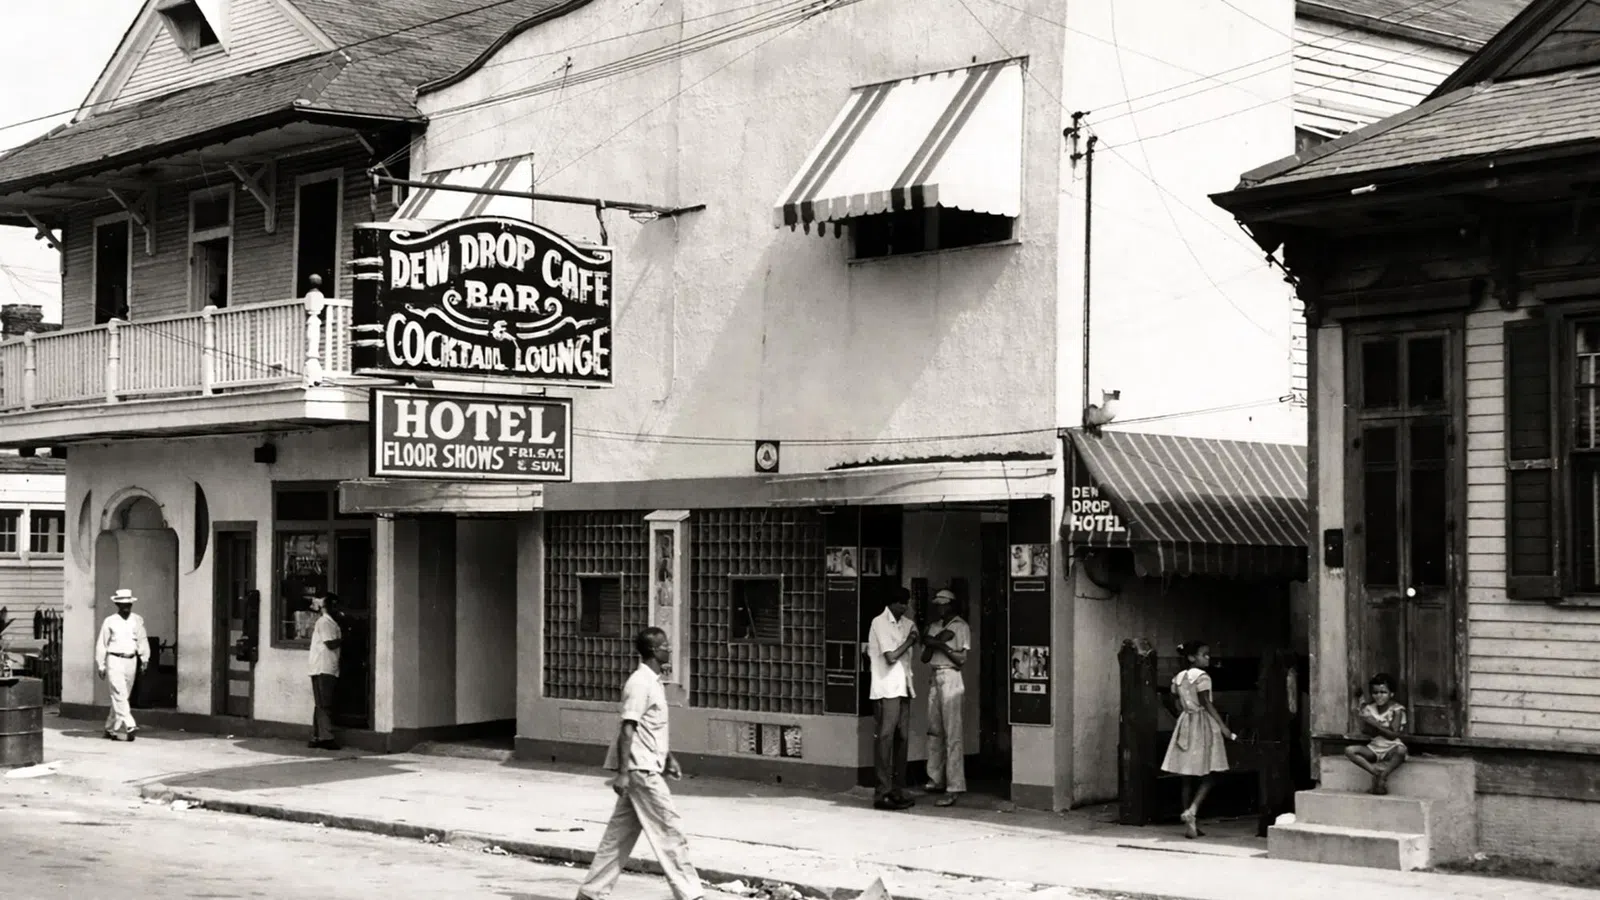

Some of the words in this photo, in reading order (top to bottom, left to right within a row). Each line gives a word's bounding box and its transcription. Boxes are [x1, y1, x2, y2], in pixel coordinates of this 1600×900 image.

[390, 240, 450, 290] DEW
[459, 232, 535, 272] DROP
[542, 249, 609, 306] CAFE
[464, 280, 540, 314] BAR
[386, 313, 507, 370] COCKTAIL
[515, 327, 610, 376] LOUNGE
[489, 320, 517, 348] &
[393, 399, 557, 444] HOTEL
[383, 441, 438, 468] FLOOR
[442, 444, 504, 470] SHOWS
[1072, 500, 1110, 513] DROP
[1070, 515, 1126, 532] HOTEL
